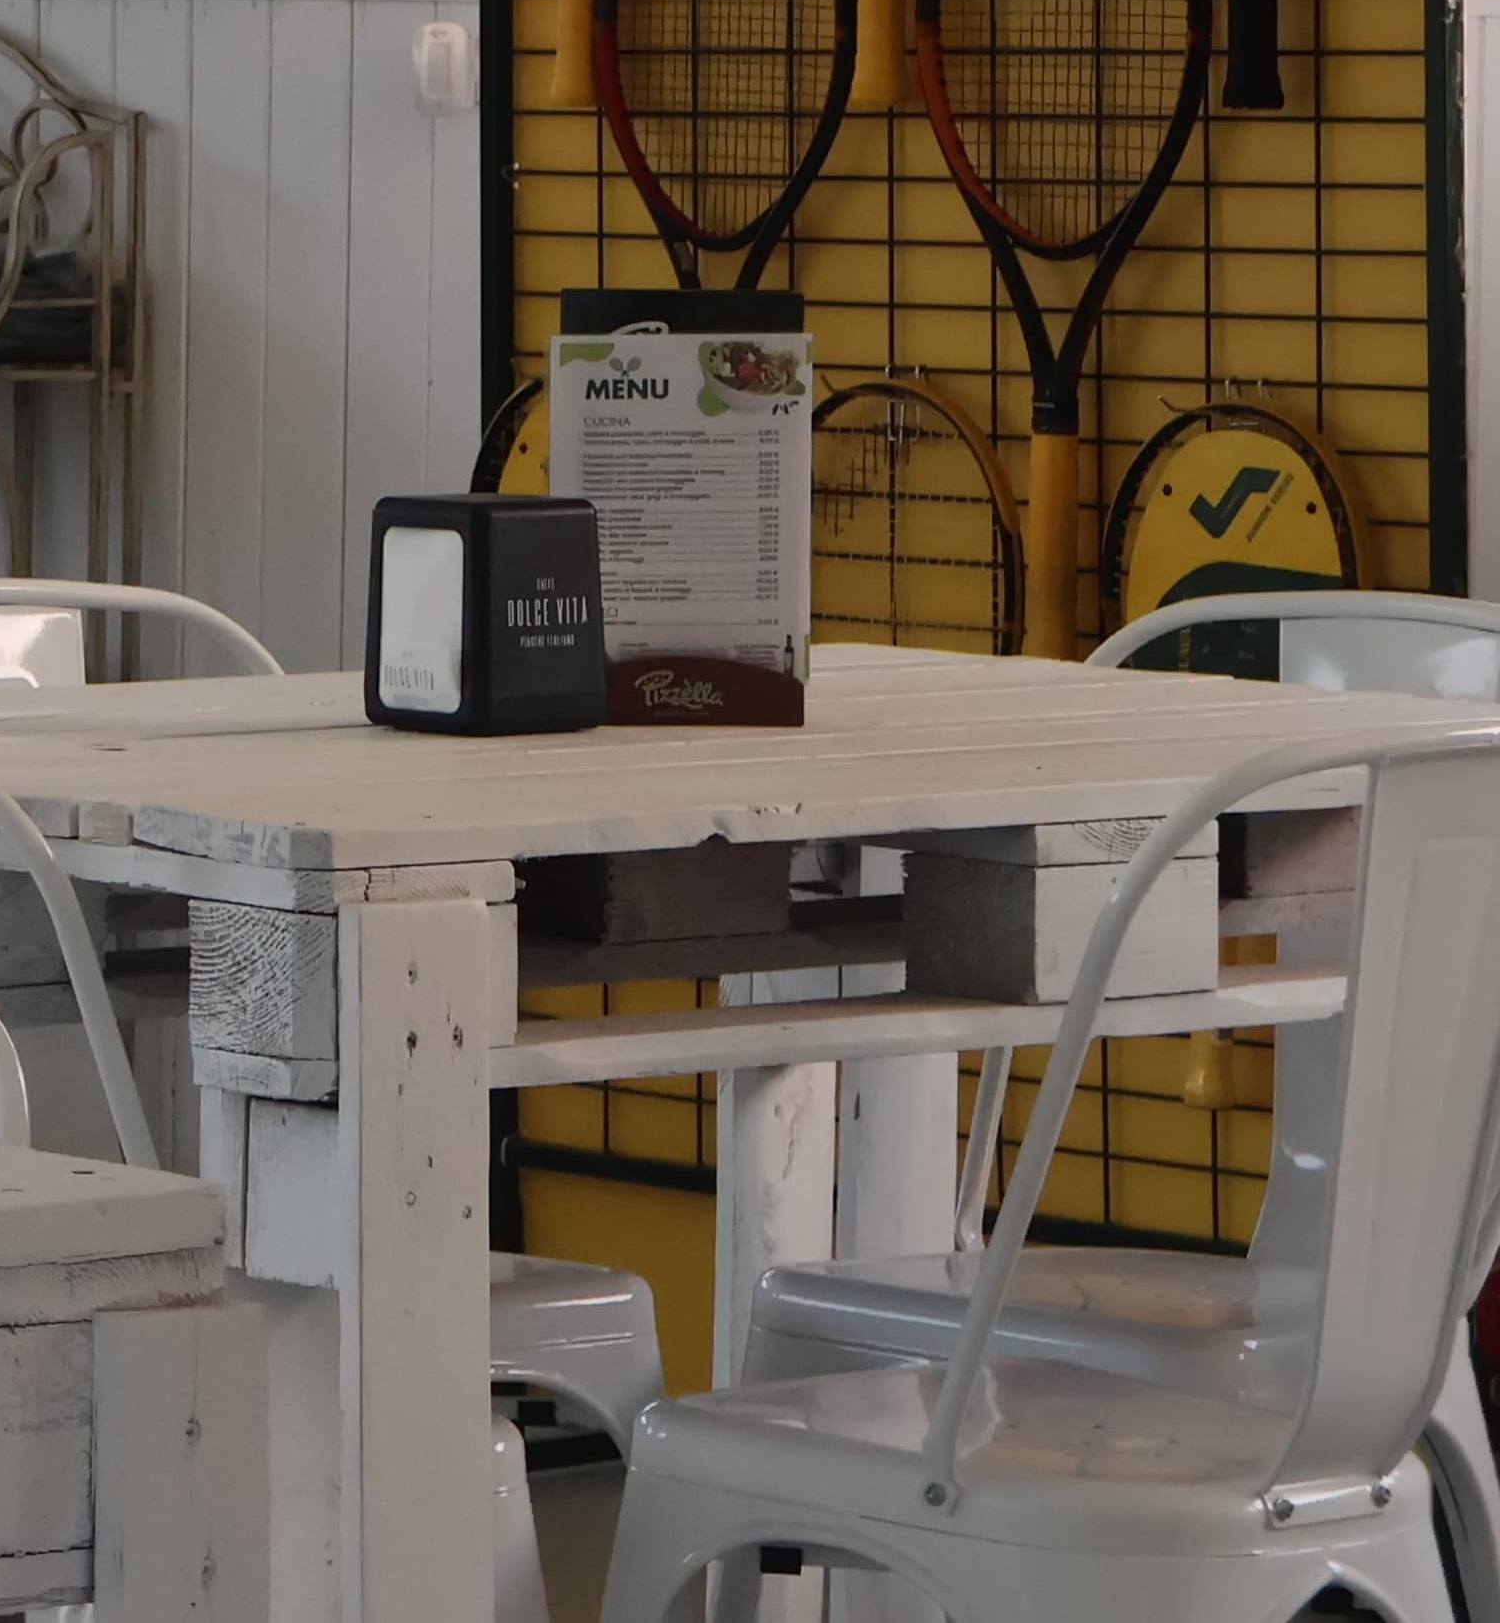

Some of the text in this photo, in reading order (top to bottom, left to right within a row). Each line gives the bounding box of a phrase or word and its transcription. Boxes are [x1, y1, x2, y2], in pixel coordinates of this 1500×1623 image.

[585, 377, 670, 401] MENU
[507, 596, 589, 628] DOLCE VITA
